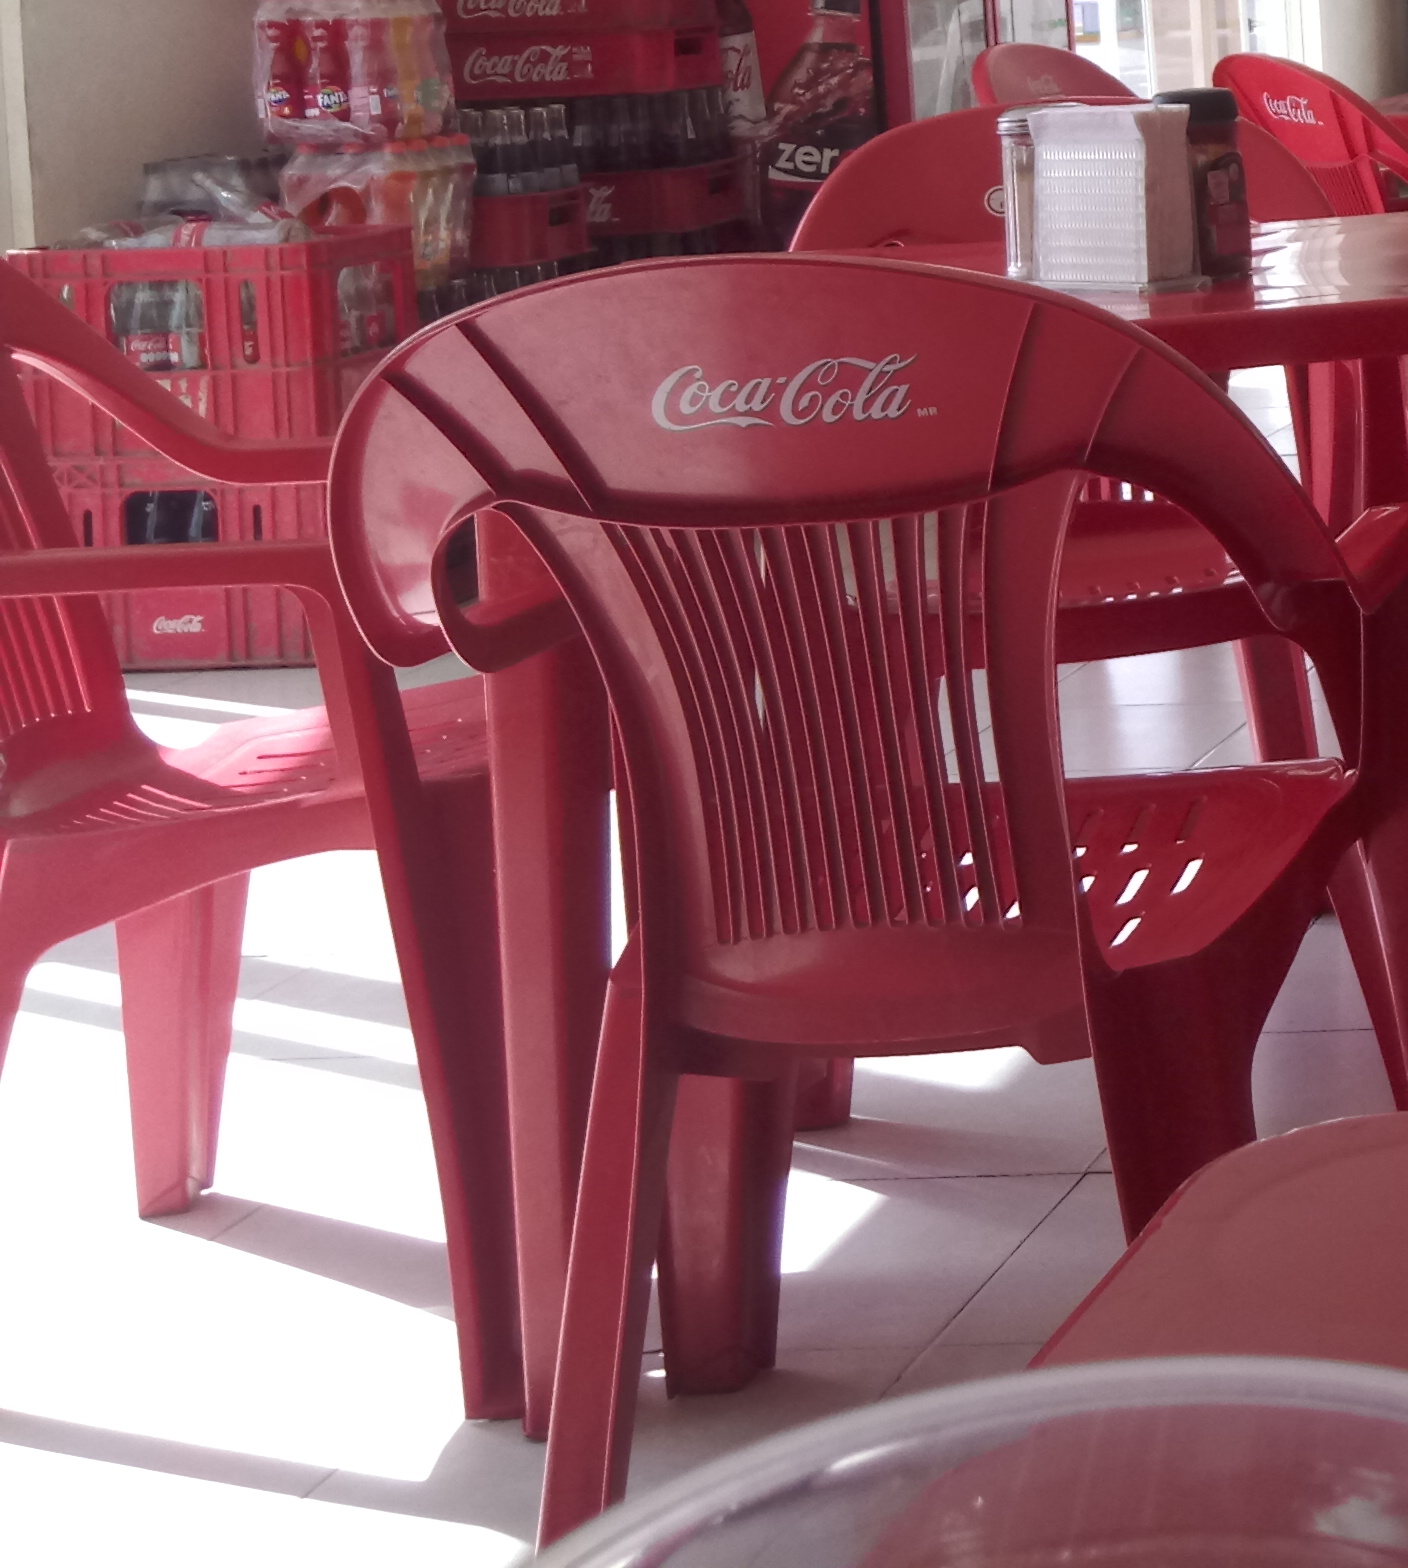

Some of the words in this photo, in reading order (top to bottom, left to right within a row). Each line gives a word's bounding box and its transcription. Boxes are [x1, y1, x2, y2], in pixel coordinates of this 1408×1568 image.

[463, 44, 572, 84] Coca-Cola
[1263, 91, 1317, 125] Coca-Cola
[775, 142, 840, 174] zer
[651, 353, 918, 431] Coca-Cola
